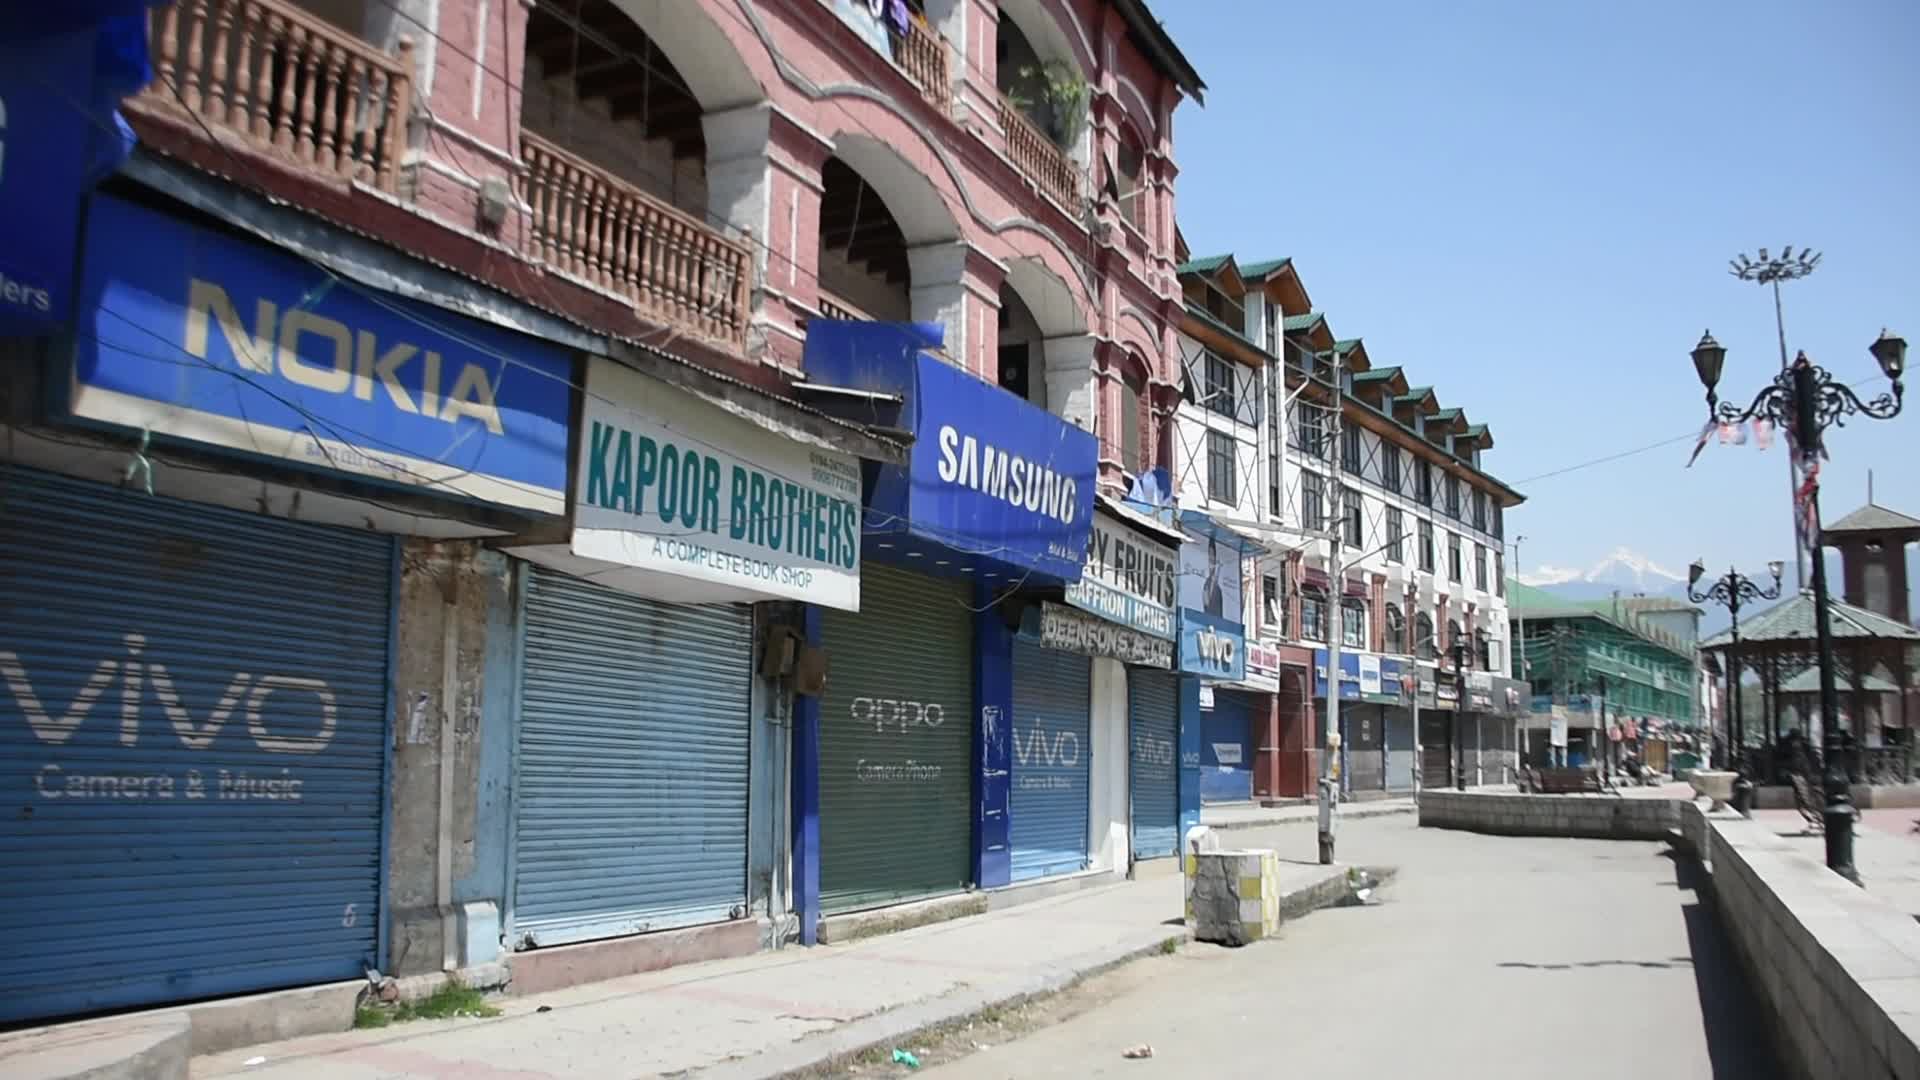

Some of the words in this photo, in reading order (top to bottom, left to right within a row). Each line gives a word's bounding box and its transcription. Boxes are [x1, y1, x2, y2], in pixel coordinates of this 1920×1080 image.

[184, 278, 505, 437] NOKIA
[587, 421, 721, 534] KAPOOR
[730, 465, 857, 569] BROTHERS
[938, 425, 1076, 525] SAMSUNG
[652, 537, 664, 555] A
[666, 540, 741, 573] COMPLETE
[743, 558, 779, 582] BOOK
[780, 566, 813, 588] SHOP
[1114, 537, 1175, 609] FRUITS
[1070, 578, 1126, 619] SAFFRON
[1135, 600, 1174, 634] HONEY
[1196, 625, 1235, 664] vivo
[0, 634, 337, 753] vivo
[851, 697, 945, 733] oppo
[1012, 718, 1080, 766] vivo
[1135, 733, 1173, 765] vivo
[36, 764, 175, 799] Camera
[185, 769, 206, 799] &
[218, 768, 304, 800] Music
